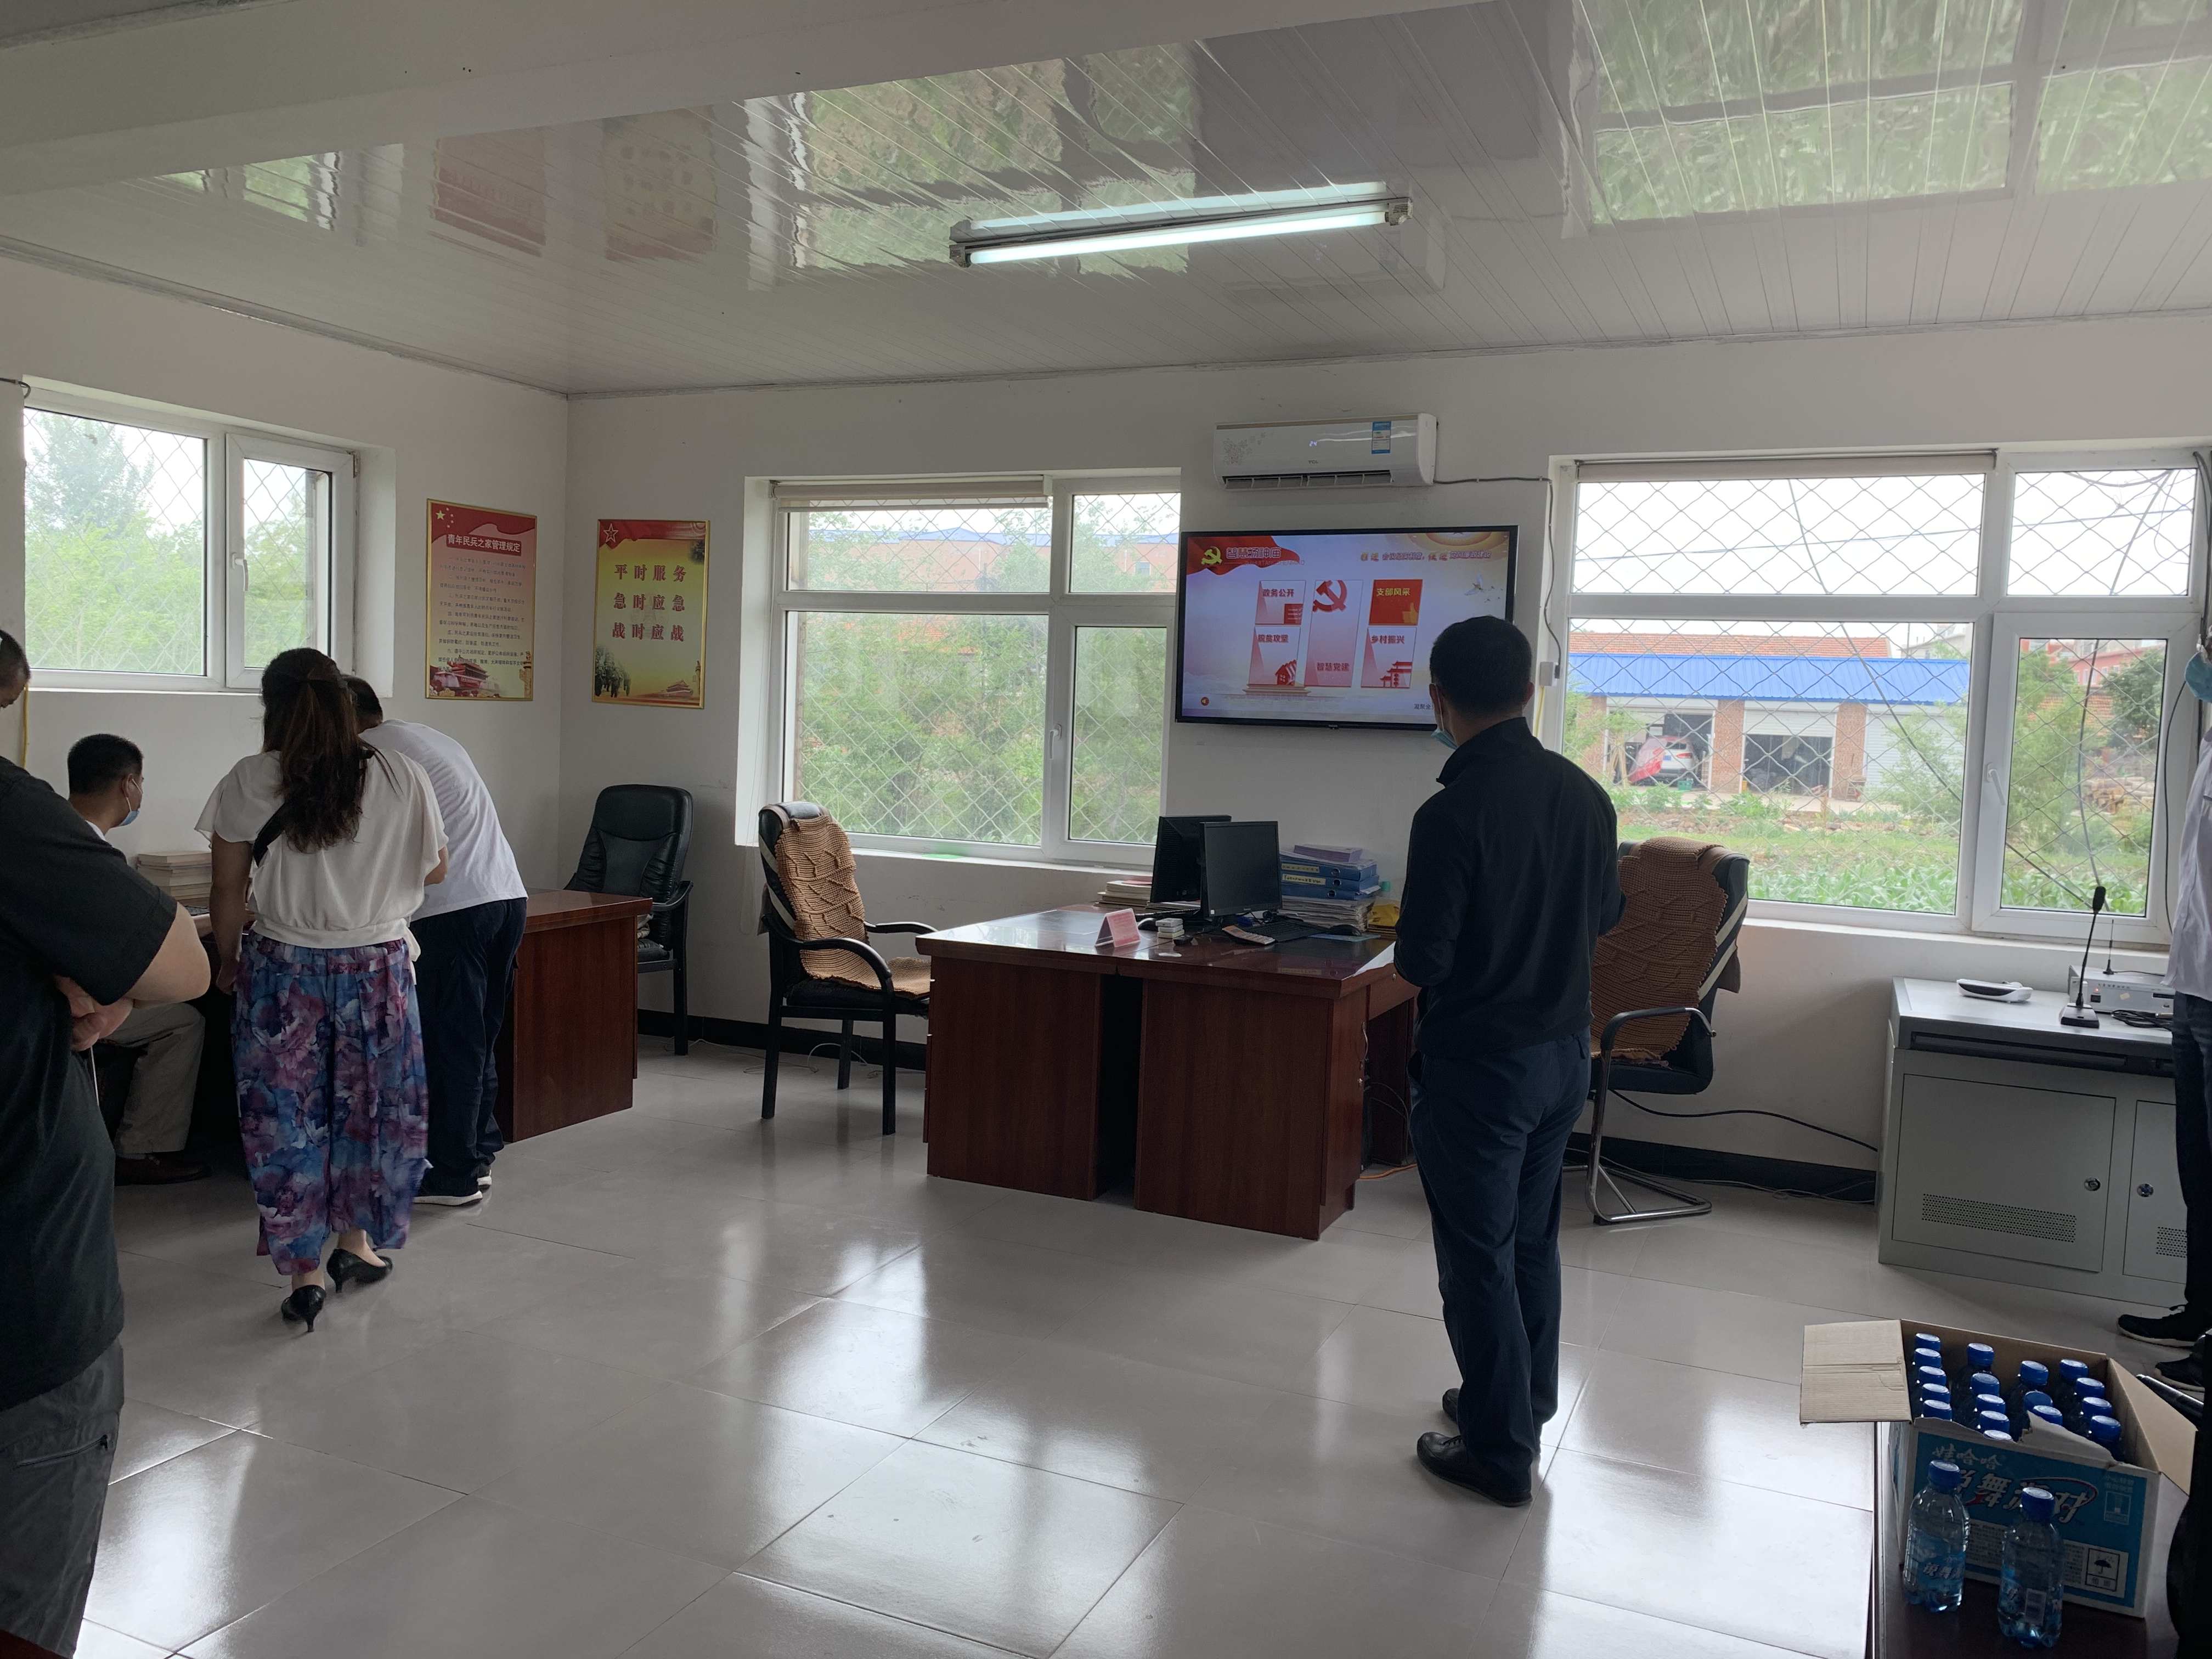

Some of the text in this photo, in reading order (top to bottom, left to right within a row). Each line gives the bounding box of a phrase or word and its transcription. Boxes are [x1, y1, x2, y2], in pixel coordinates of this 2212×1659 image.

[448, 534, 521, 552] 青年民兵之家管理规定
[614, 564, 687, 582] 平时服务
[1263, 588, 1294, 597] 政务公开
[1376, 588, 1411, 596] 支部风采
[613, 592, 686, 612] 急时应急
[612, 622, 684, 642] 战时应战
[1257, 634, 1288, 643] 脱贫攻坚
[1371, 635, 1405, 644] 乡村振兴
[1317, 662, 1349, 672] 智慧党建
[1932, 1443, 2001, 1470] 娃哈哈
